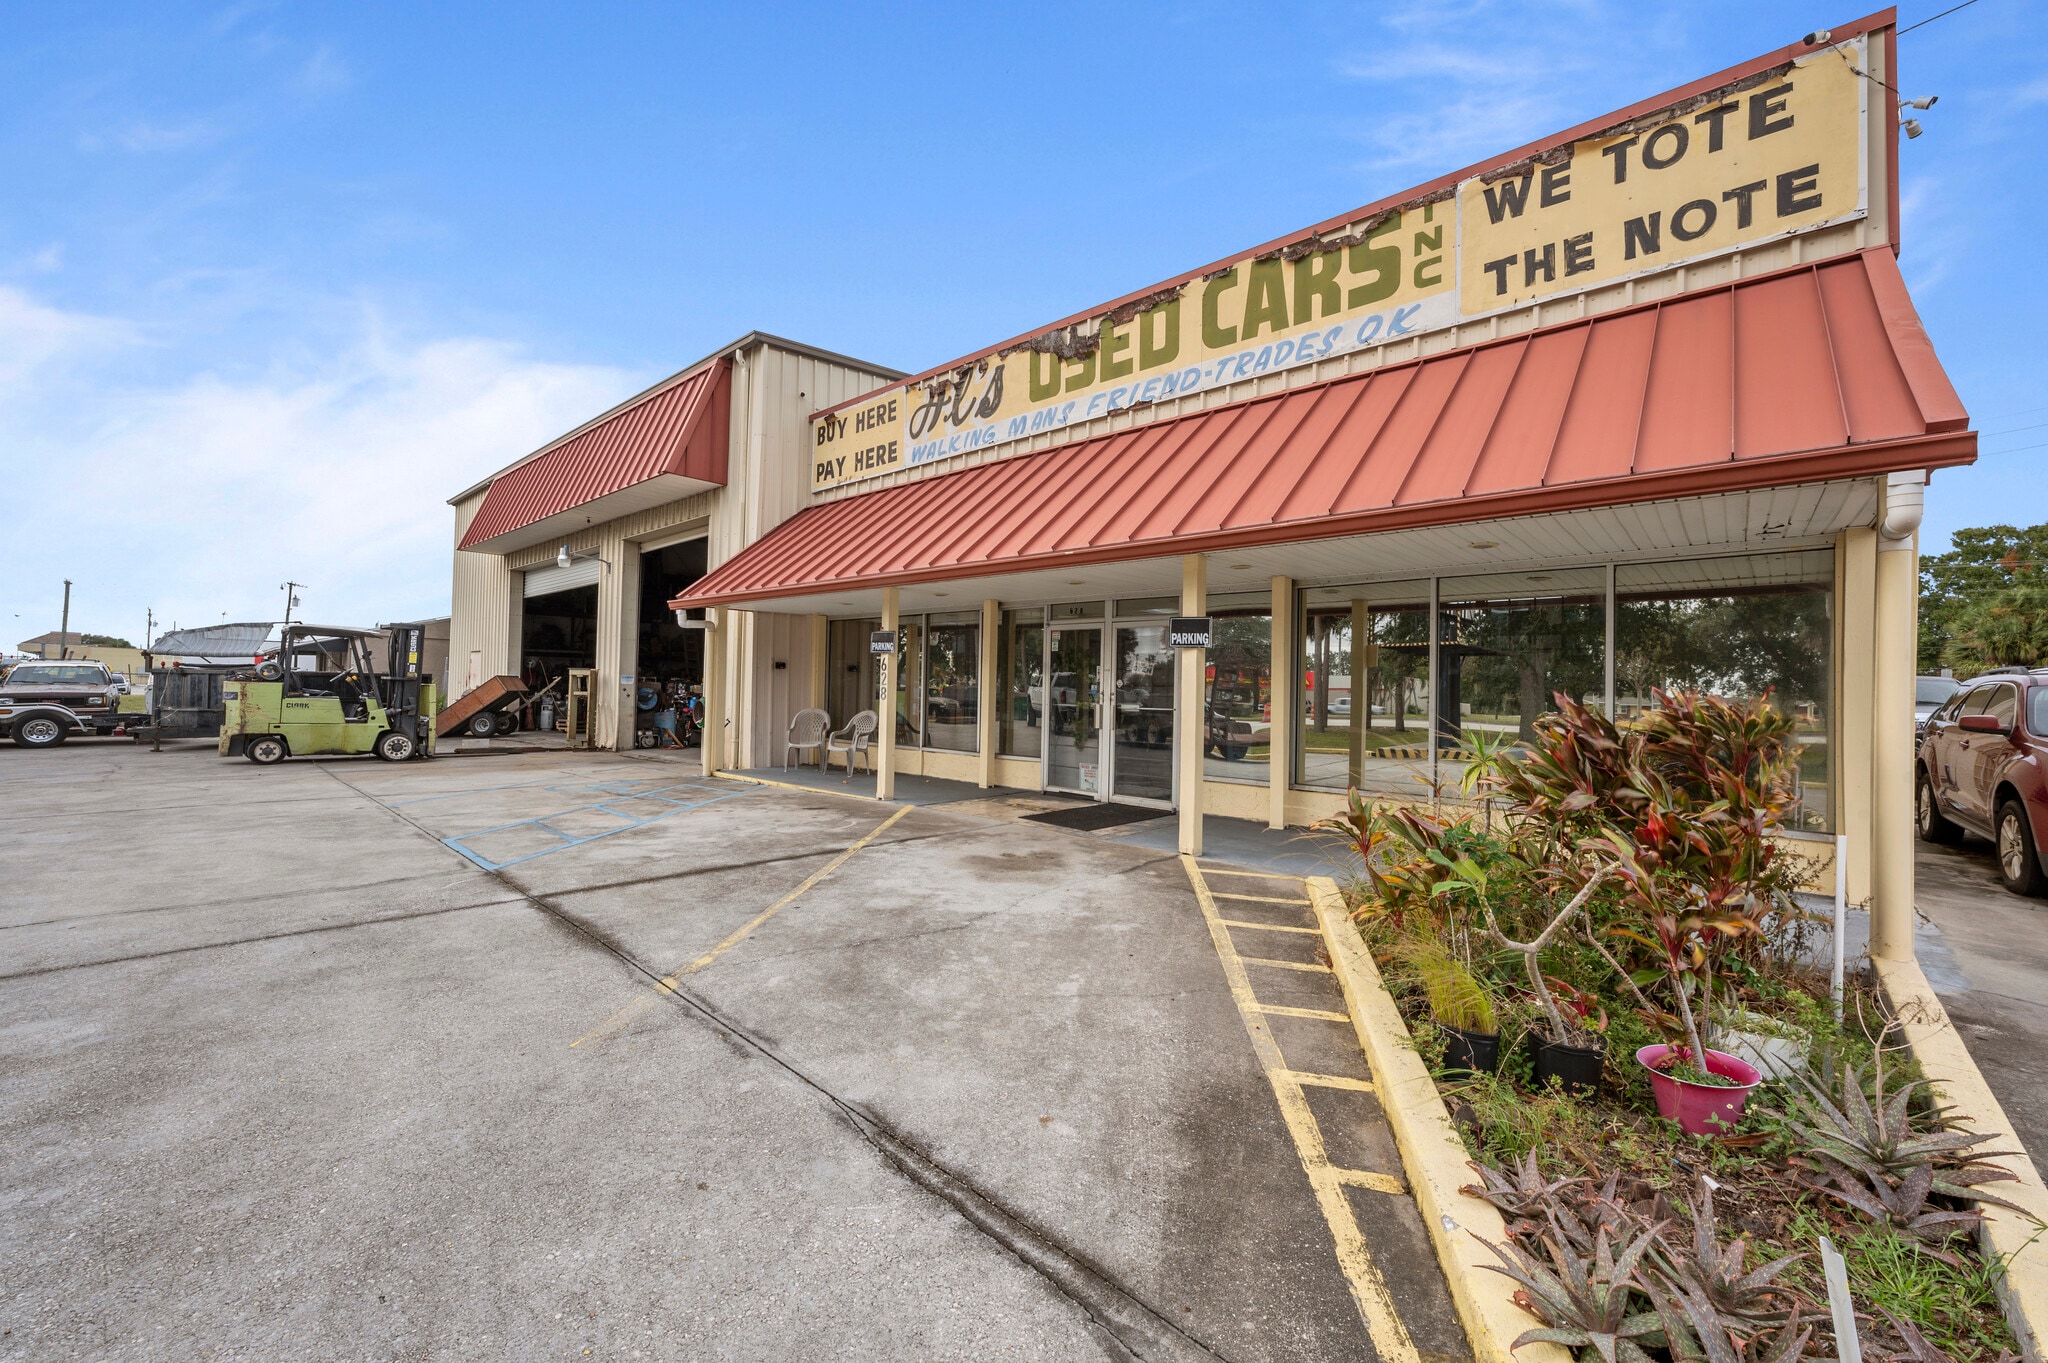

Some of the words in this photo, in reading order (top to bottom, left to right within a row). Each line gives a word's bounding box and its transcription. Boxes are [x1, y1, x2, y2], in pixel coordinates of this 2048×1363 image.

[1483, 159, 1571, 225] WE
[1602, 82, 1795, 185] TOTE
[1413, 204, 1443, 289] INC
[1483, 231, 1595, 297] THE
[1623, 163, 1823, 261] NOTE
[1029, 298, 1181, 403] USED
[1202, 212, 1402, 350] CARS
[911, 424, 997, 464] WALKING
[1008, 401, 1076, 438] MANS
[1356, 303, 1422, 345] OK
[817, 416, 848, 447] BUY
[855, 398, 897, 434] HERE
[816, 455, 847, 484] PAY
[854, 440, 898, 473] HERE
[871, 642, 894, 653] PARKING
[1171, 632, 1209, 645] PARKING
[880, 657, 888, 701] 628
